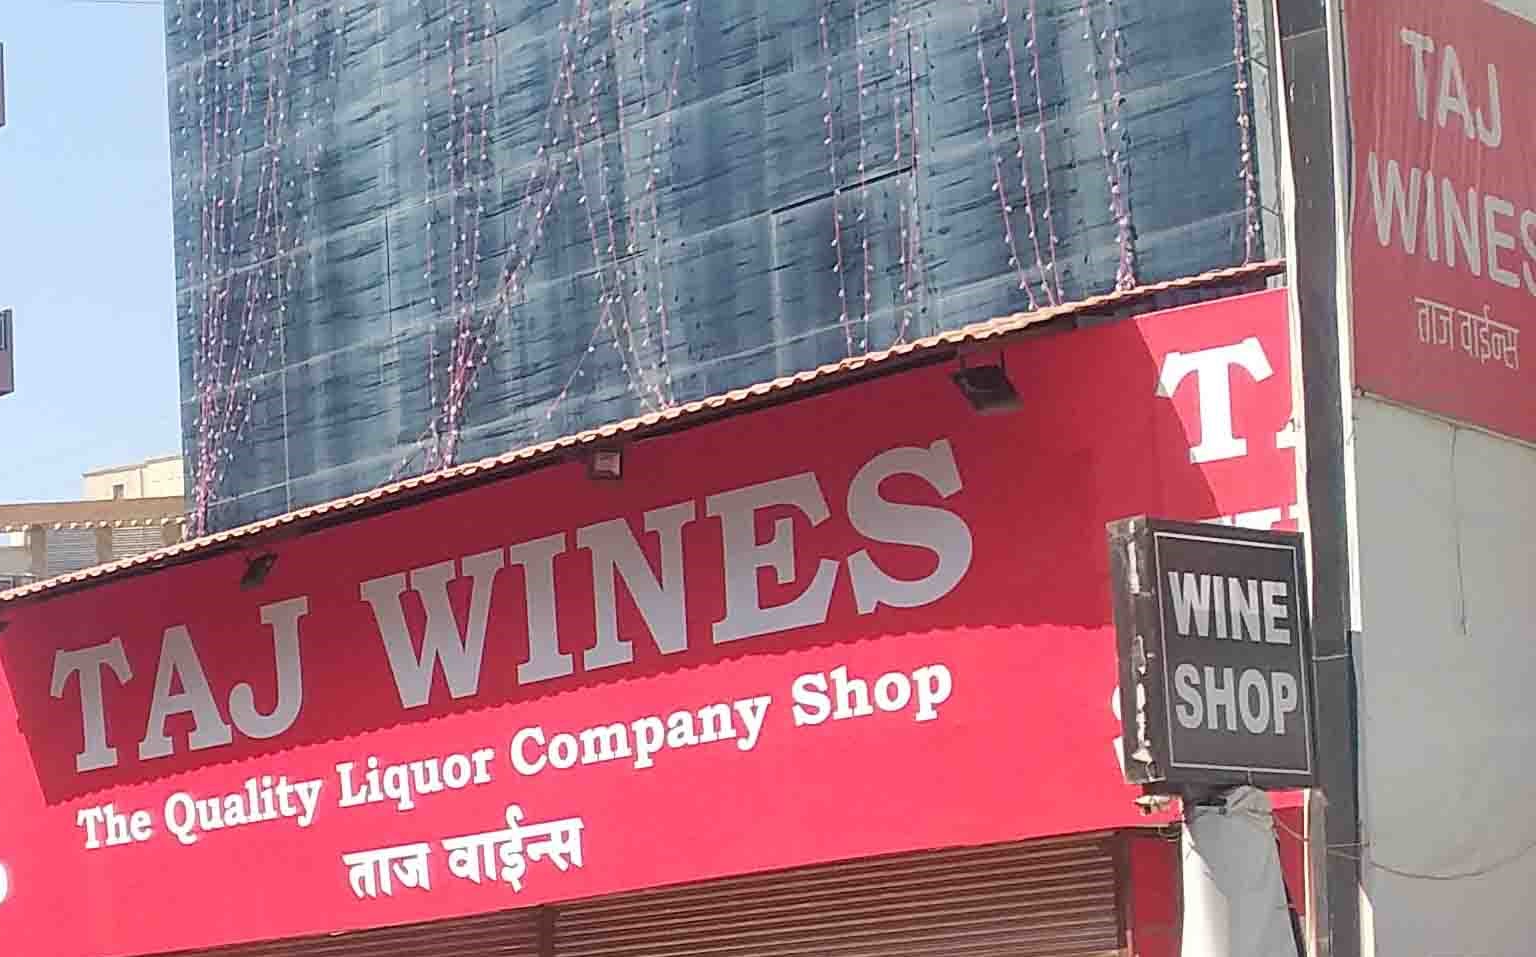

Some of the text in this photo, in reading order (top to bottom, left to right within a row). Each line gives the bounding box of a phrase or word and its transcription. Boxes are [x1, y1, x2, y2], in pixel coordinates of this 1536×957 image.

[1399, 26, 1502, 147] TAJ
[1414, 295, 1456, 348] ताज
[49, 436, 975, 774] TAJ WINES
[1168, 571, 1292, 645] WINE
[1174, 663, 1298, 735] SHOP
[76, 659, 954, 850] The Quality Liquor Company Shop
[343, 804, 586, 900] ताज वाईन्स
